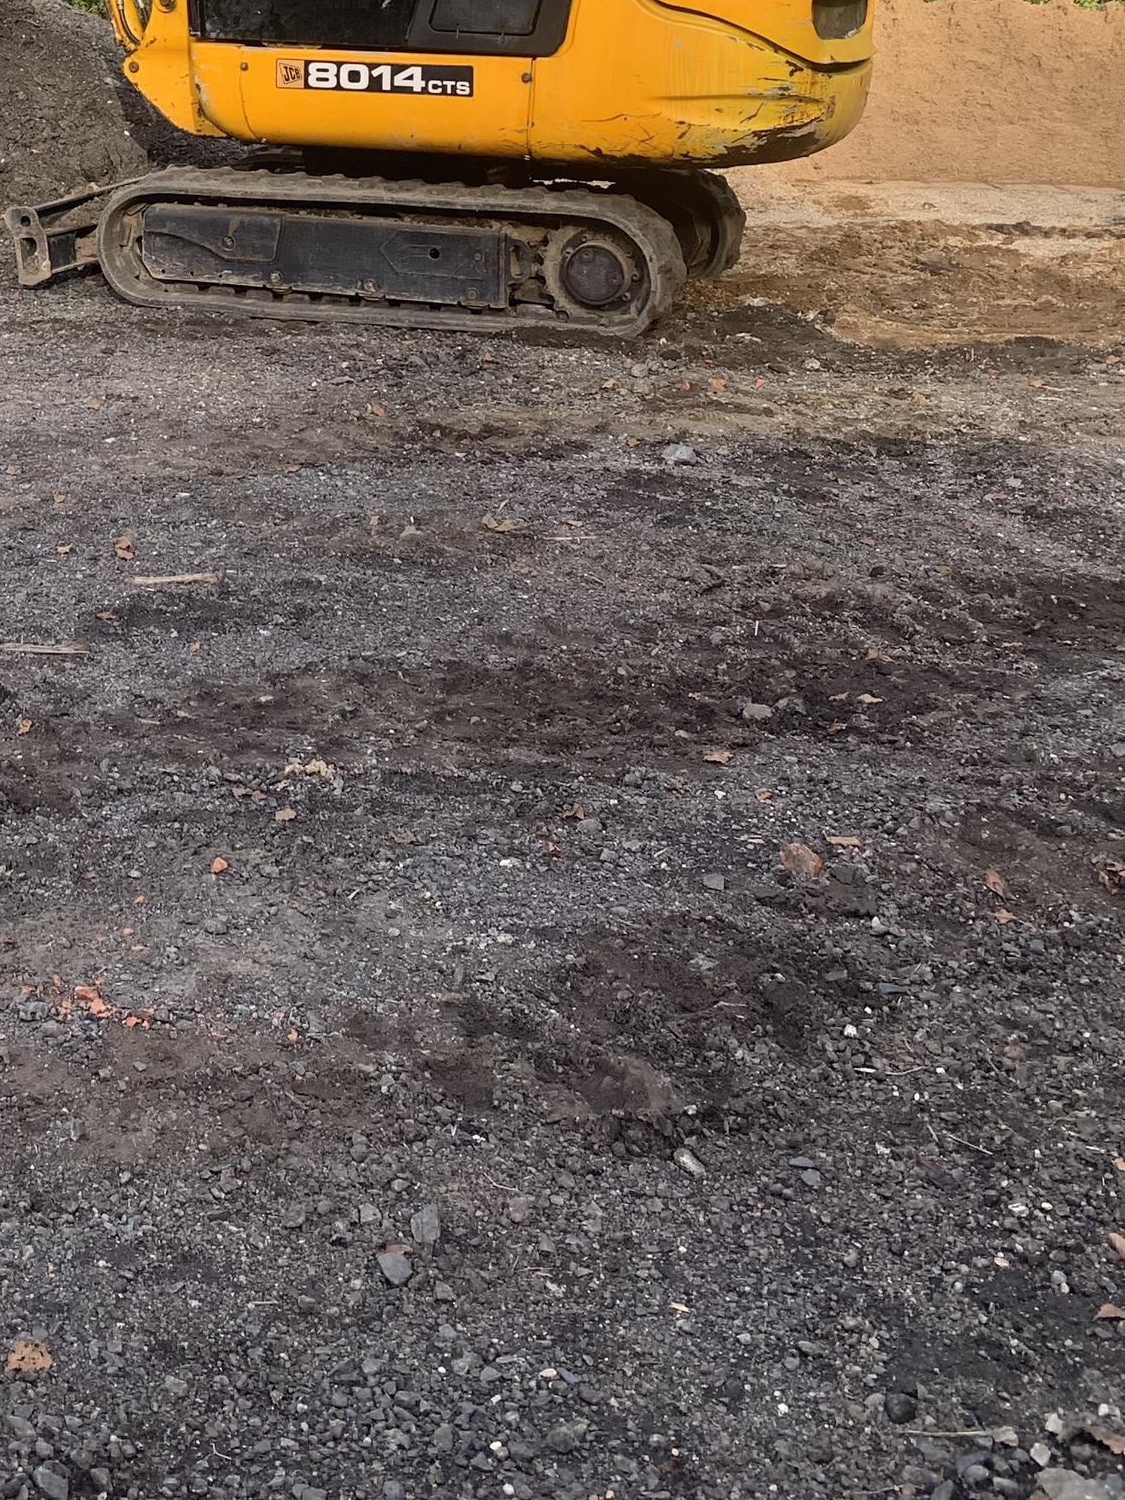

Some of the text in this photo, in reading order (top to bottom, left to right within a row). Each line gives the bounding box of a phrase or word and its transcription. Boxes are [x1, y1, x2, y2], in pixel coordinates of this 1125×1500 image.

[283, 62, 470, 96] JCB 8014 CTS
